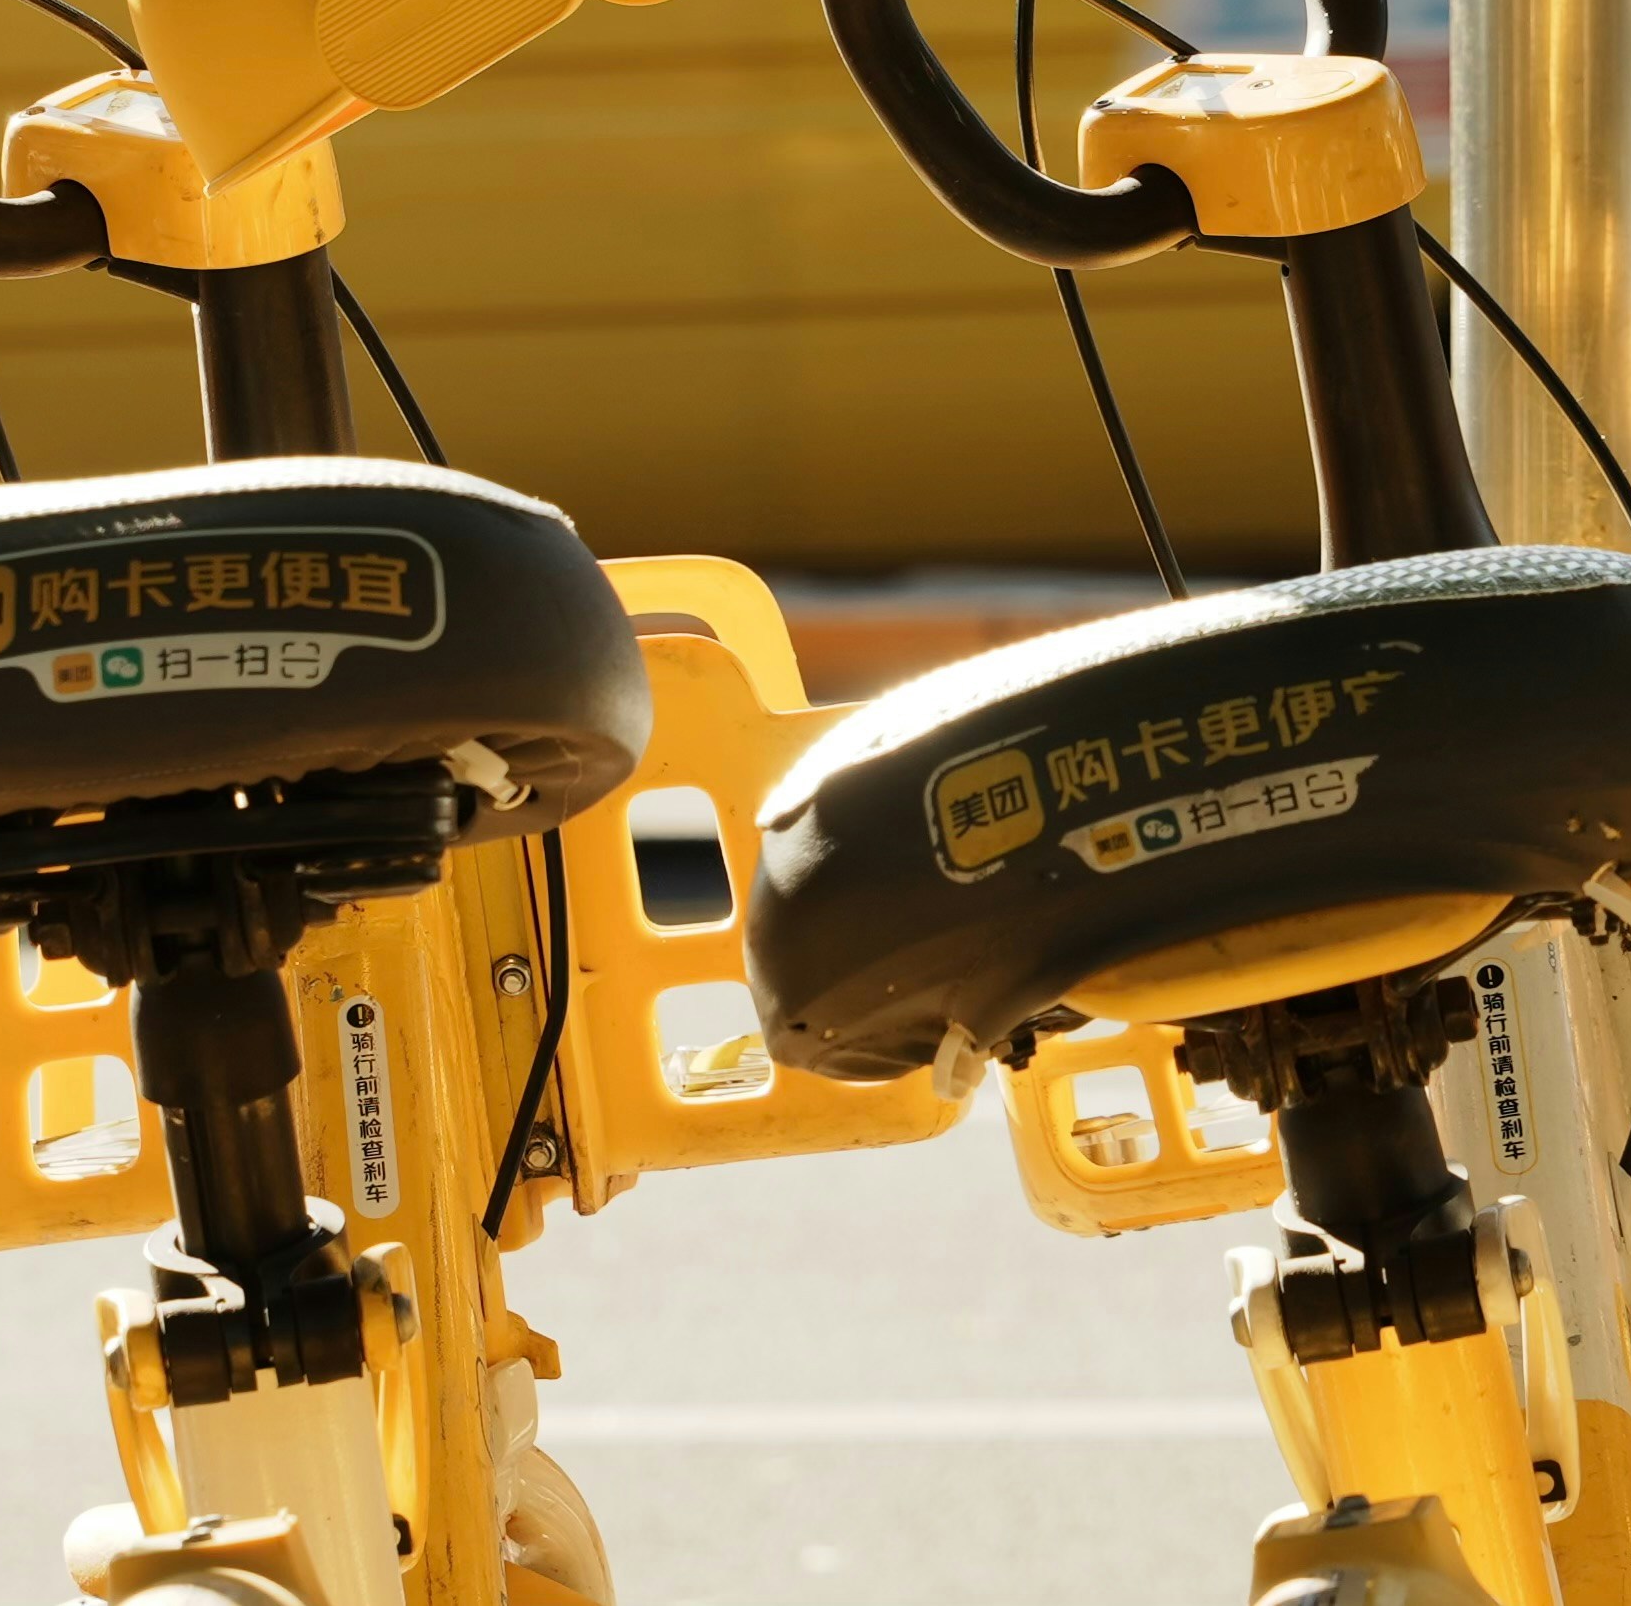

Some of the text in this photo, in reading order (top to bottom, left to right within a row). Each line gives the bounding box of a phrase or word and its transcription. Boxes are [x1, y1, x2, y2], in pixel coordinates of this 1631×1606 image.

[29, 551, 412, 632] 购卡更便宜
[157, 644, 269, 681] 扫一扫
[948, 777, 1030, 839] 美团
[1188, 782, 1300, 834] 扫一扫
[1482, 992, 1527, 1160] 骑行前请检查刹车
[350, 1031, 389, 1204] 骑行前请检查刹车
